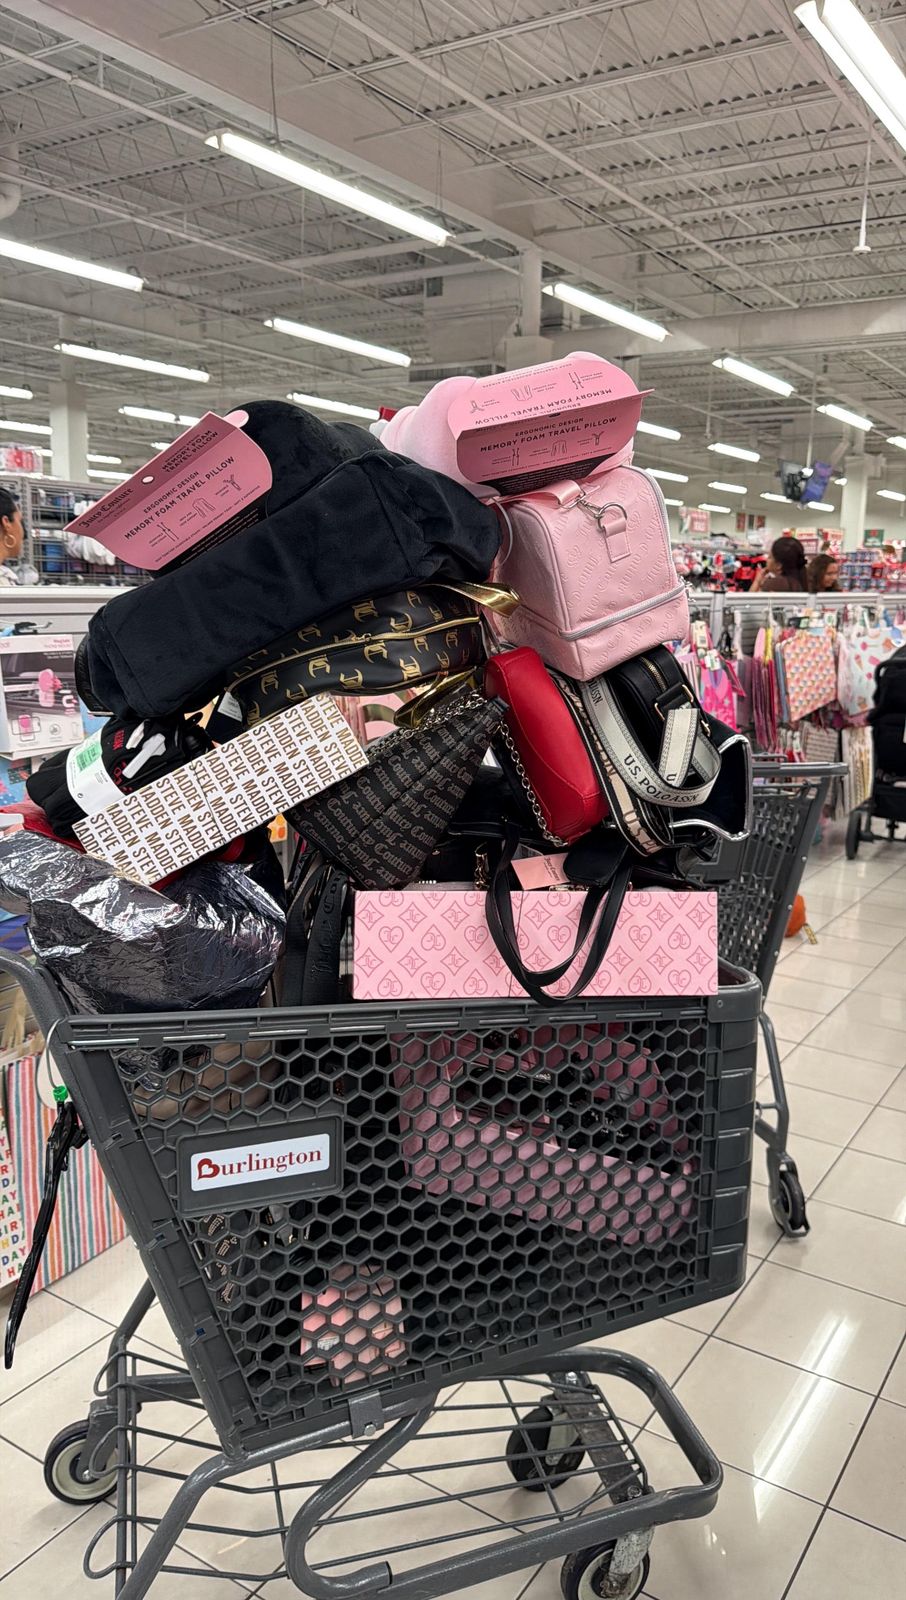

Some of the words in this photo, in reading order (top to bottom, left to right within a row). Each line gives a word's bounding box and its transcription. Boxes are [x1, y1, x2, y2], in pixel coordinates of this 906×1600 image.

[512, 404, 545, 417] TRAVEL
[547, 398, 573, 407] FOAM
[576, 388, 612, 401] MEMORY
[476, 413, 508, 426] PILLOW
[480, 439, 518, 452] MEMORY
[521, 433, 546, 444] FOAM
[549, 426, 582, 437] TRAVEL
[584, 417, 618, 429] PILLOW
[515, 423, 556, 436] ERGONOMIC
[558, 418, 584, 428] DESIGN
[125, 516, 153, 539] MEMORY
[155, 500, 176, 516] FOAM
[176, 480, 205, 500] TRAVEL
[205, 456, 234, 479] PILLOW
[144, 488, 177, 513] ERGONOMIC
[177, 472, 198, 488] DESIGN
[253, 726, 281, 762] STEVE
[285, 708, 312, 744] STEVE
[221, 743, 249, 779] STEVE
[293, 759, 320, 795] STEVE
[324, 742, 352, 778] STEVE
[624, 753, 641, 780] U.S.
[639, 777, 671, 801] POLO
[156, 778, 185, 814] STEVE
[189, 760, 217, 797] STEVE
[262, 776, 289, 812] STEVE
[123, 796, 153, 832] STEVE
[198, 812, 226, 847] STEVE
[230, 794, 258, 830] STEVE
[90, 814, 120, 850] STEVE
[165, 829, 194, 865] STEVE
[133, 847, 162, 883] STEVE
[197, 1149, 321, 1180] Burlington
